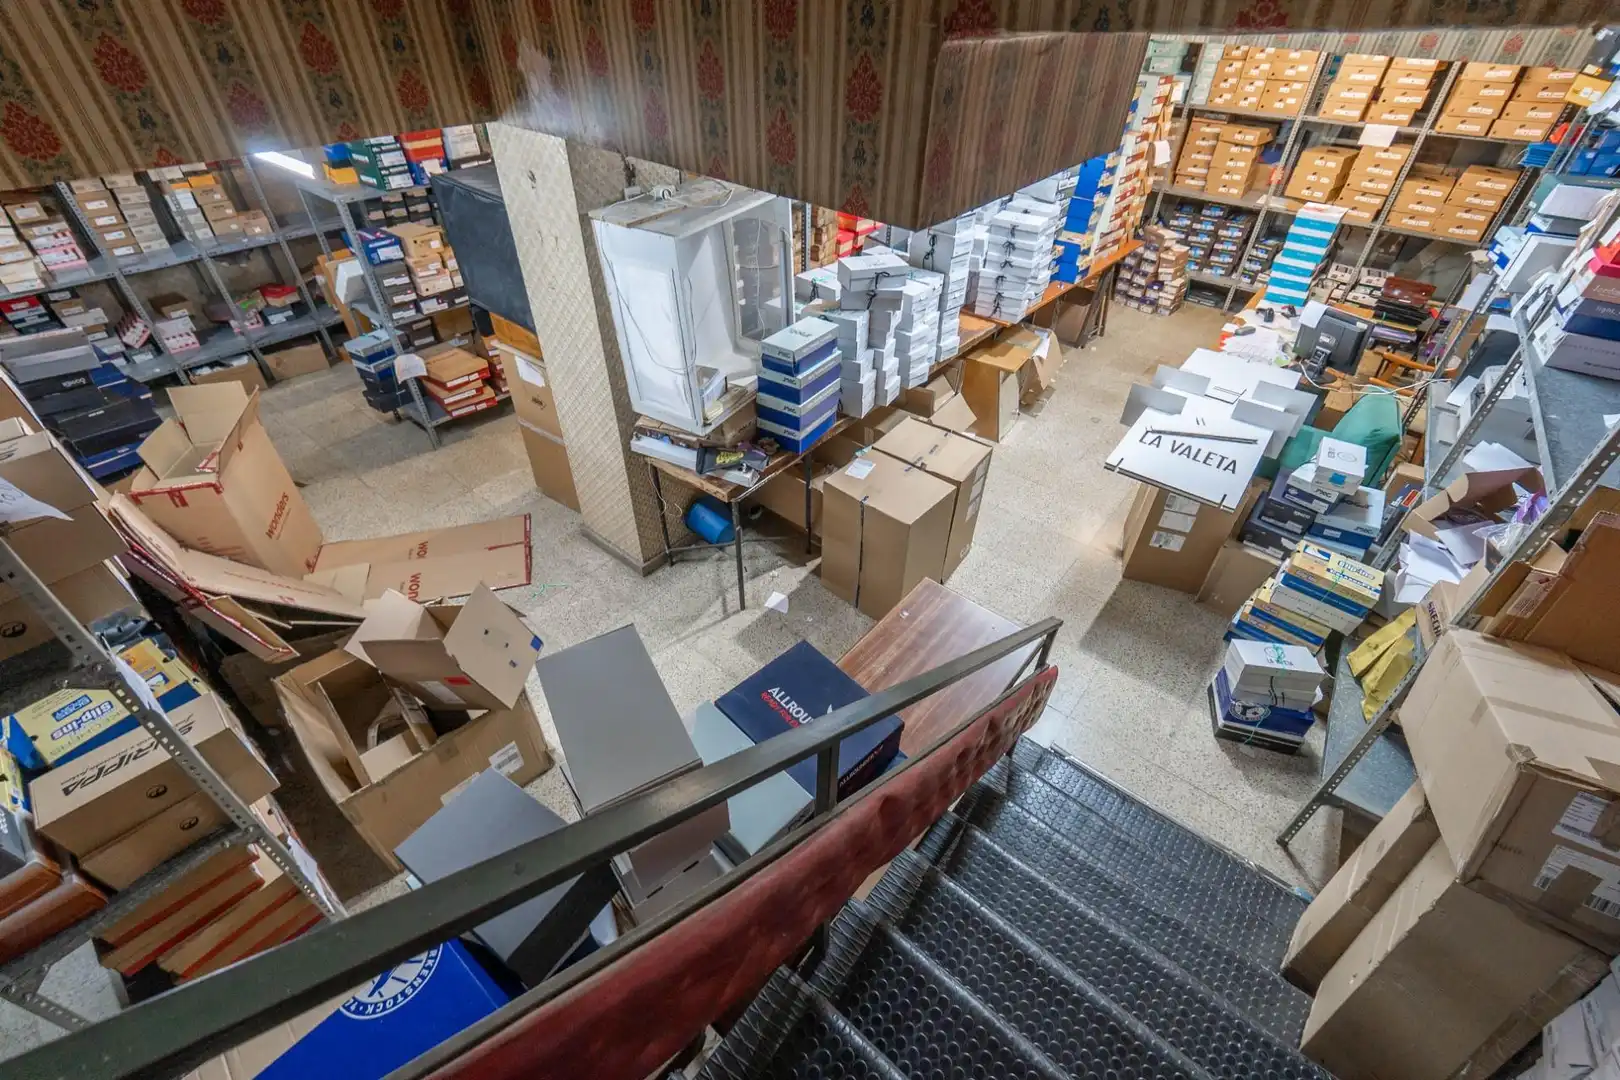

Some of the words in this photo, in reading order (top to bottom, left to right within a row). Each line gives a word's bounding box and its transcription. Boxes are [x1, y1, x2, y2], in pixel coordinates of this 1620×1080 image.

[1138, 430, 1161, 449] LA
[1170, 440, 1238, 475] VALETA
[265, 491, 290, 539] wonders
[408, 573, 421, 600] won
[365, 949, 438, 1015] RKENSTOCK
